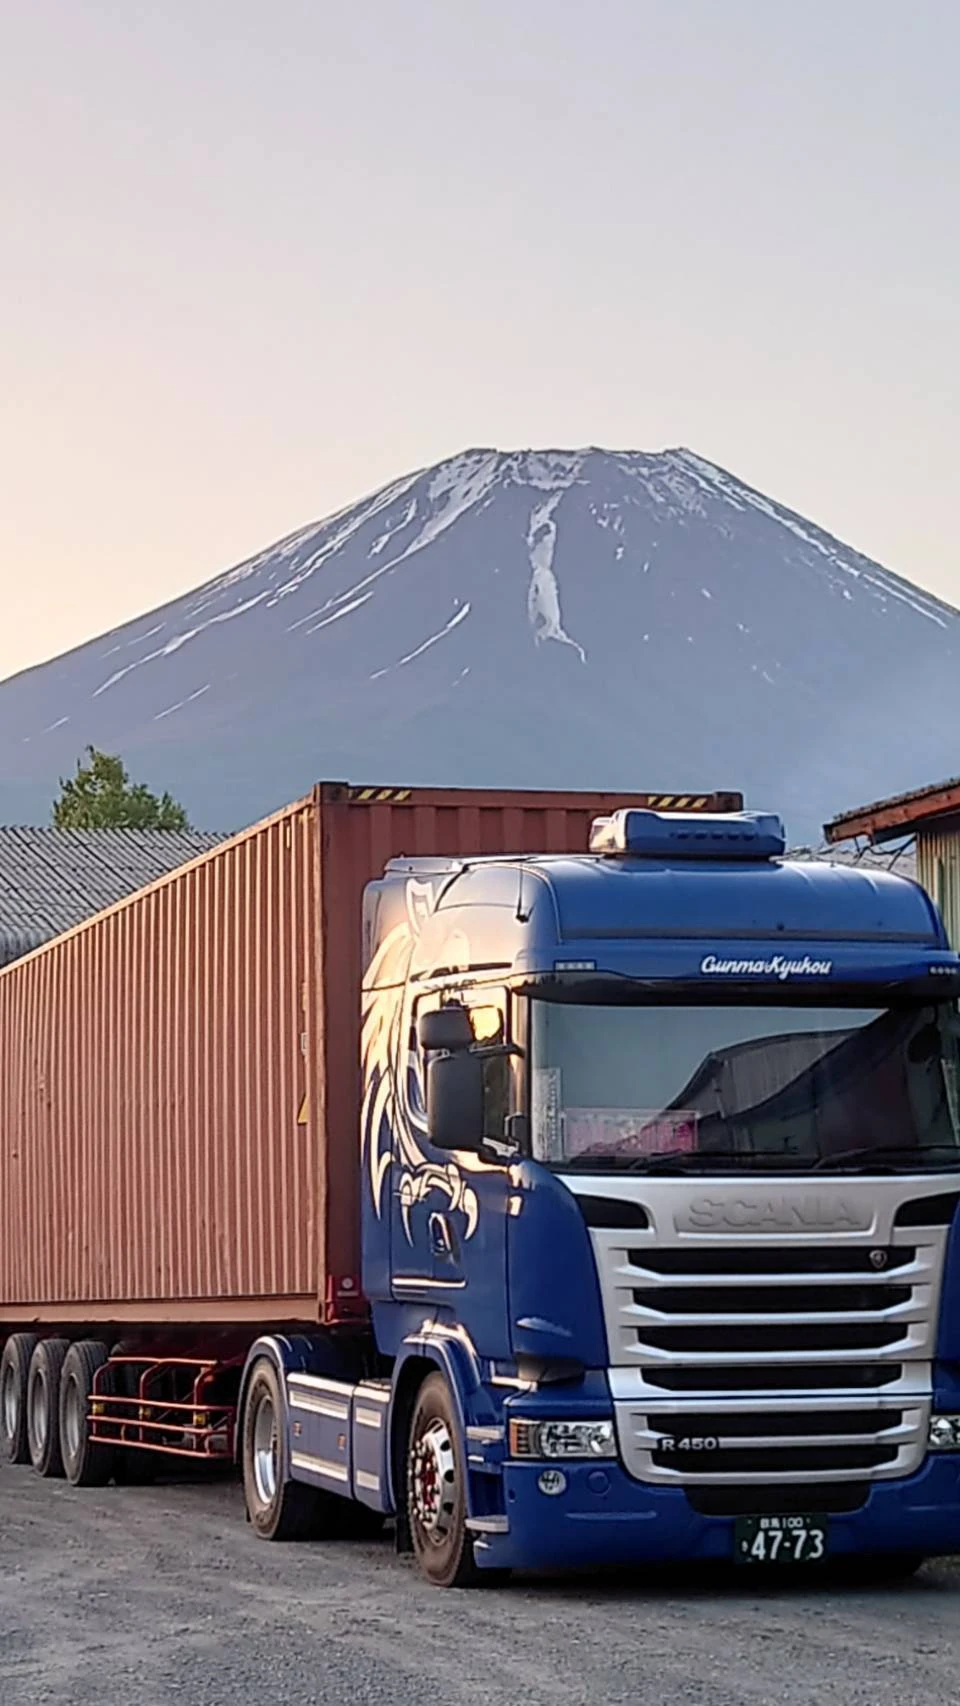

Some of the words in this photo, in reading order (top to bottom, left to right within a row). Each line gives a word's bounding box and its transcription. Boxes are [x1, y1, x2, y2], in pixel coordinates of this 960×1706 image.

[688, 1196, 862, 1228] SCANIA
[678, 1437, 717, 1451] 450
[750, 1529, 825, 1560] 47-73
